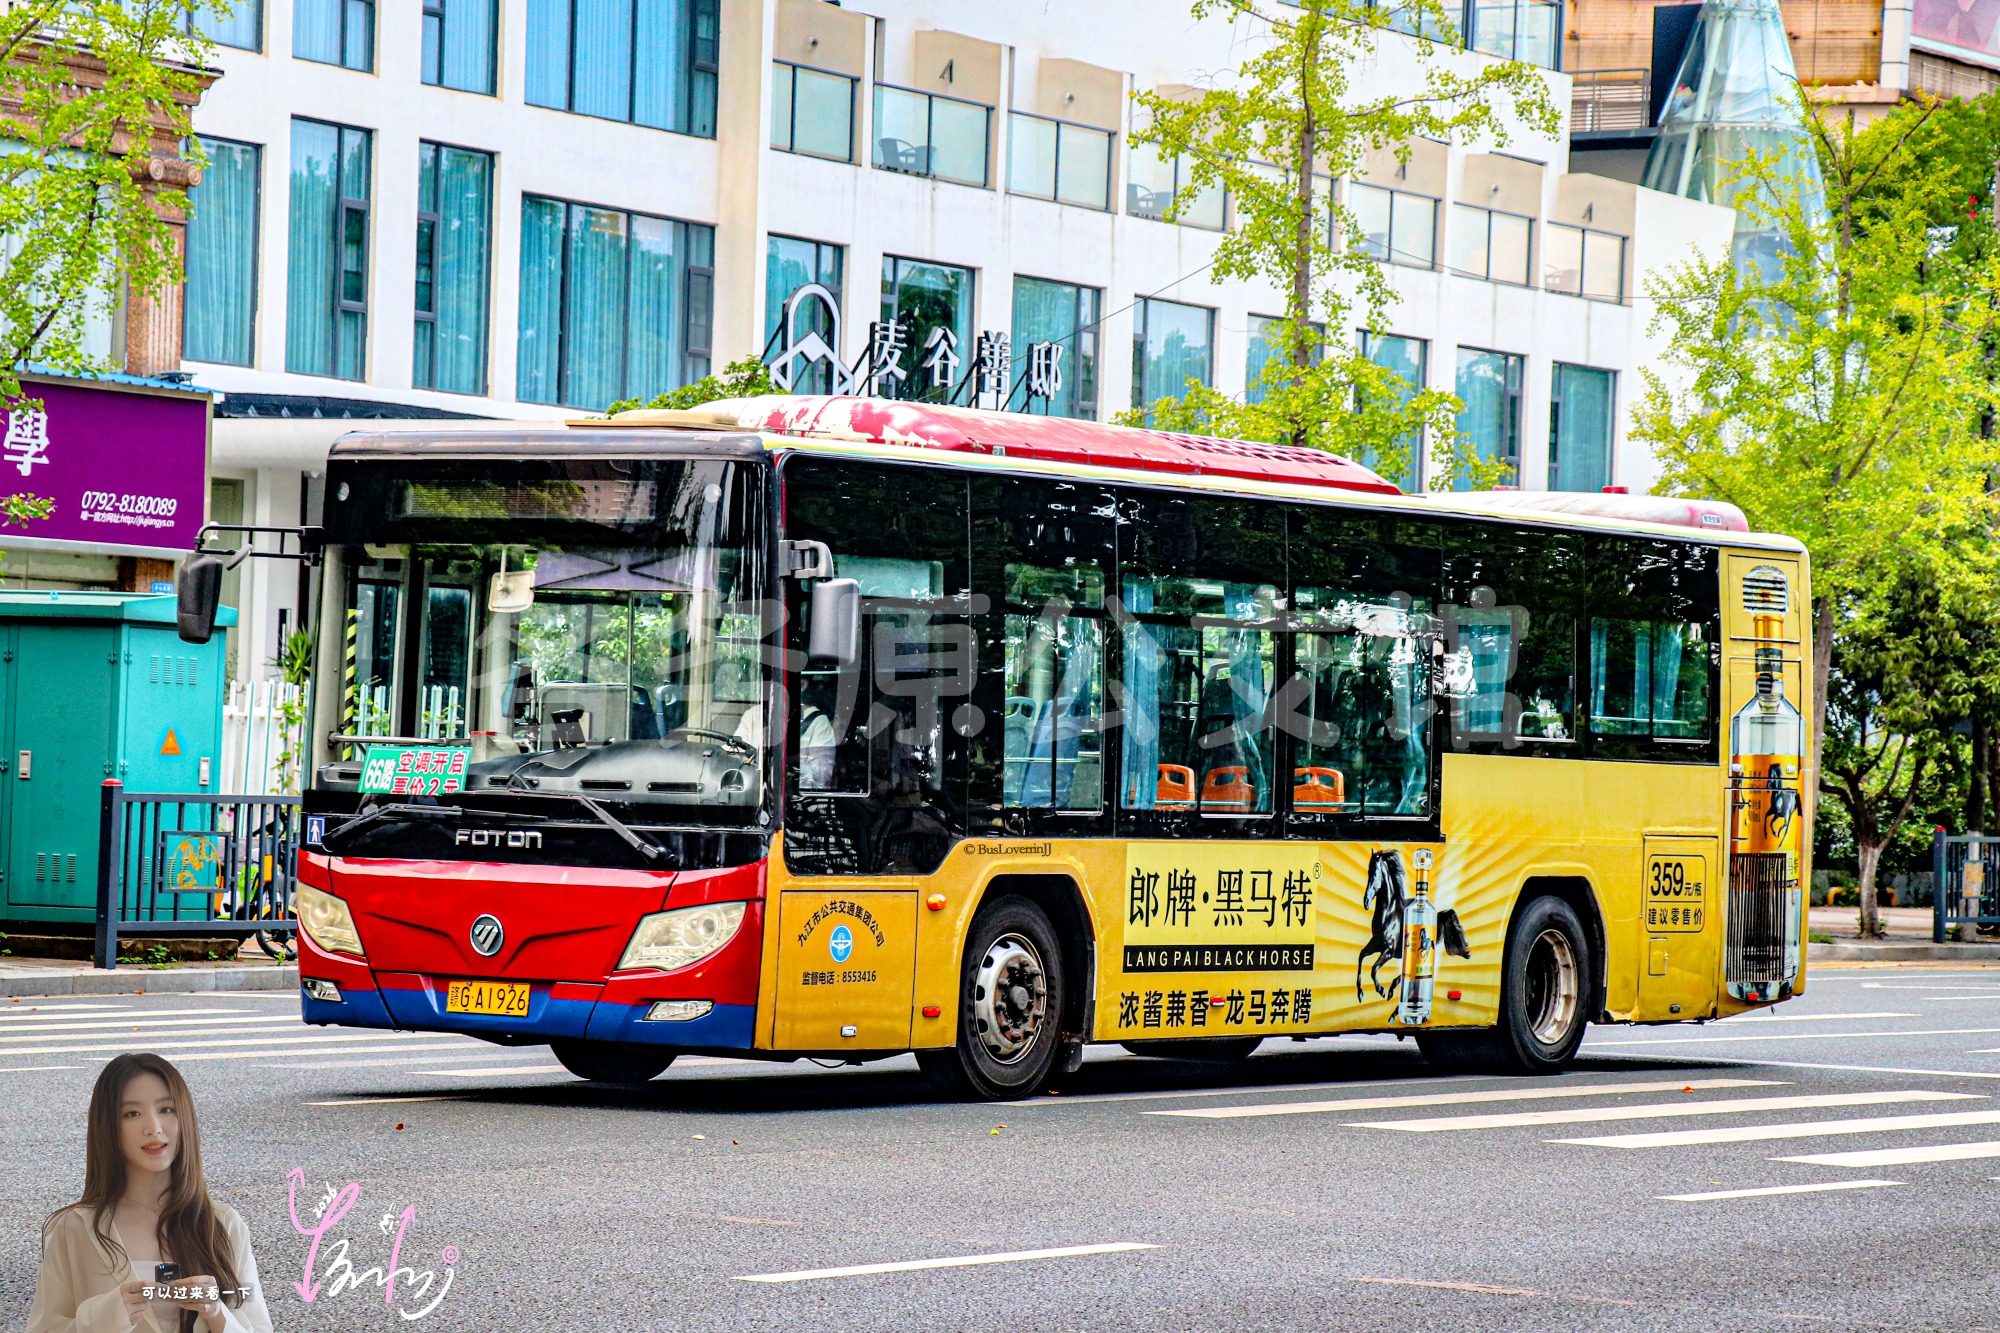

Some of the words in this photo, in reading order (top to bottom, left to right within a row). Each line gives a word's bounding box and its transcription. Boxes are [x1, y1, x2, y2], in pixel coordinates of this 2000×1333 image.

[81, 490, 177, 517] 0792-8180089
[364, 758, 397, 790] 66路
[397, 751, 465, 775] 空调开启
[455, 829, 542, 849] FOTON
[797, 899, 885, 948] 九江市公共交通集团公司
[1648, 908, 1703, 926] 建议零售价
[1126, 950, 1168, 967] LANG
[1173, 951, 1199, 966] PAI
[1204, 950, 1255, 966] BLACK
[1259, 949, 1311, 966] HORSE
[1118, 989, 1210, 1030] 浓酱兼香
[1225, 988, 1312, 1025] 龙马奔腾
